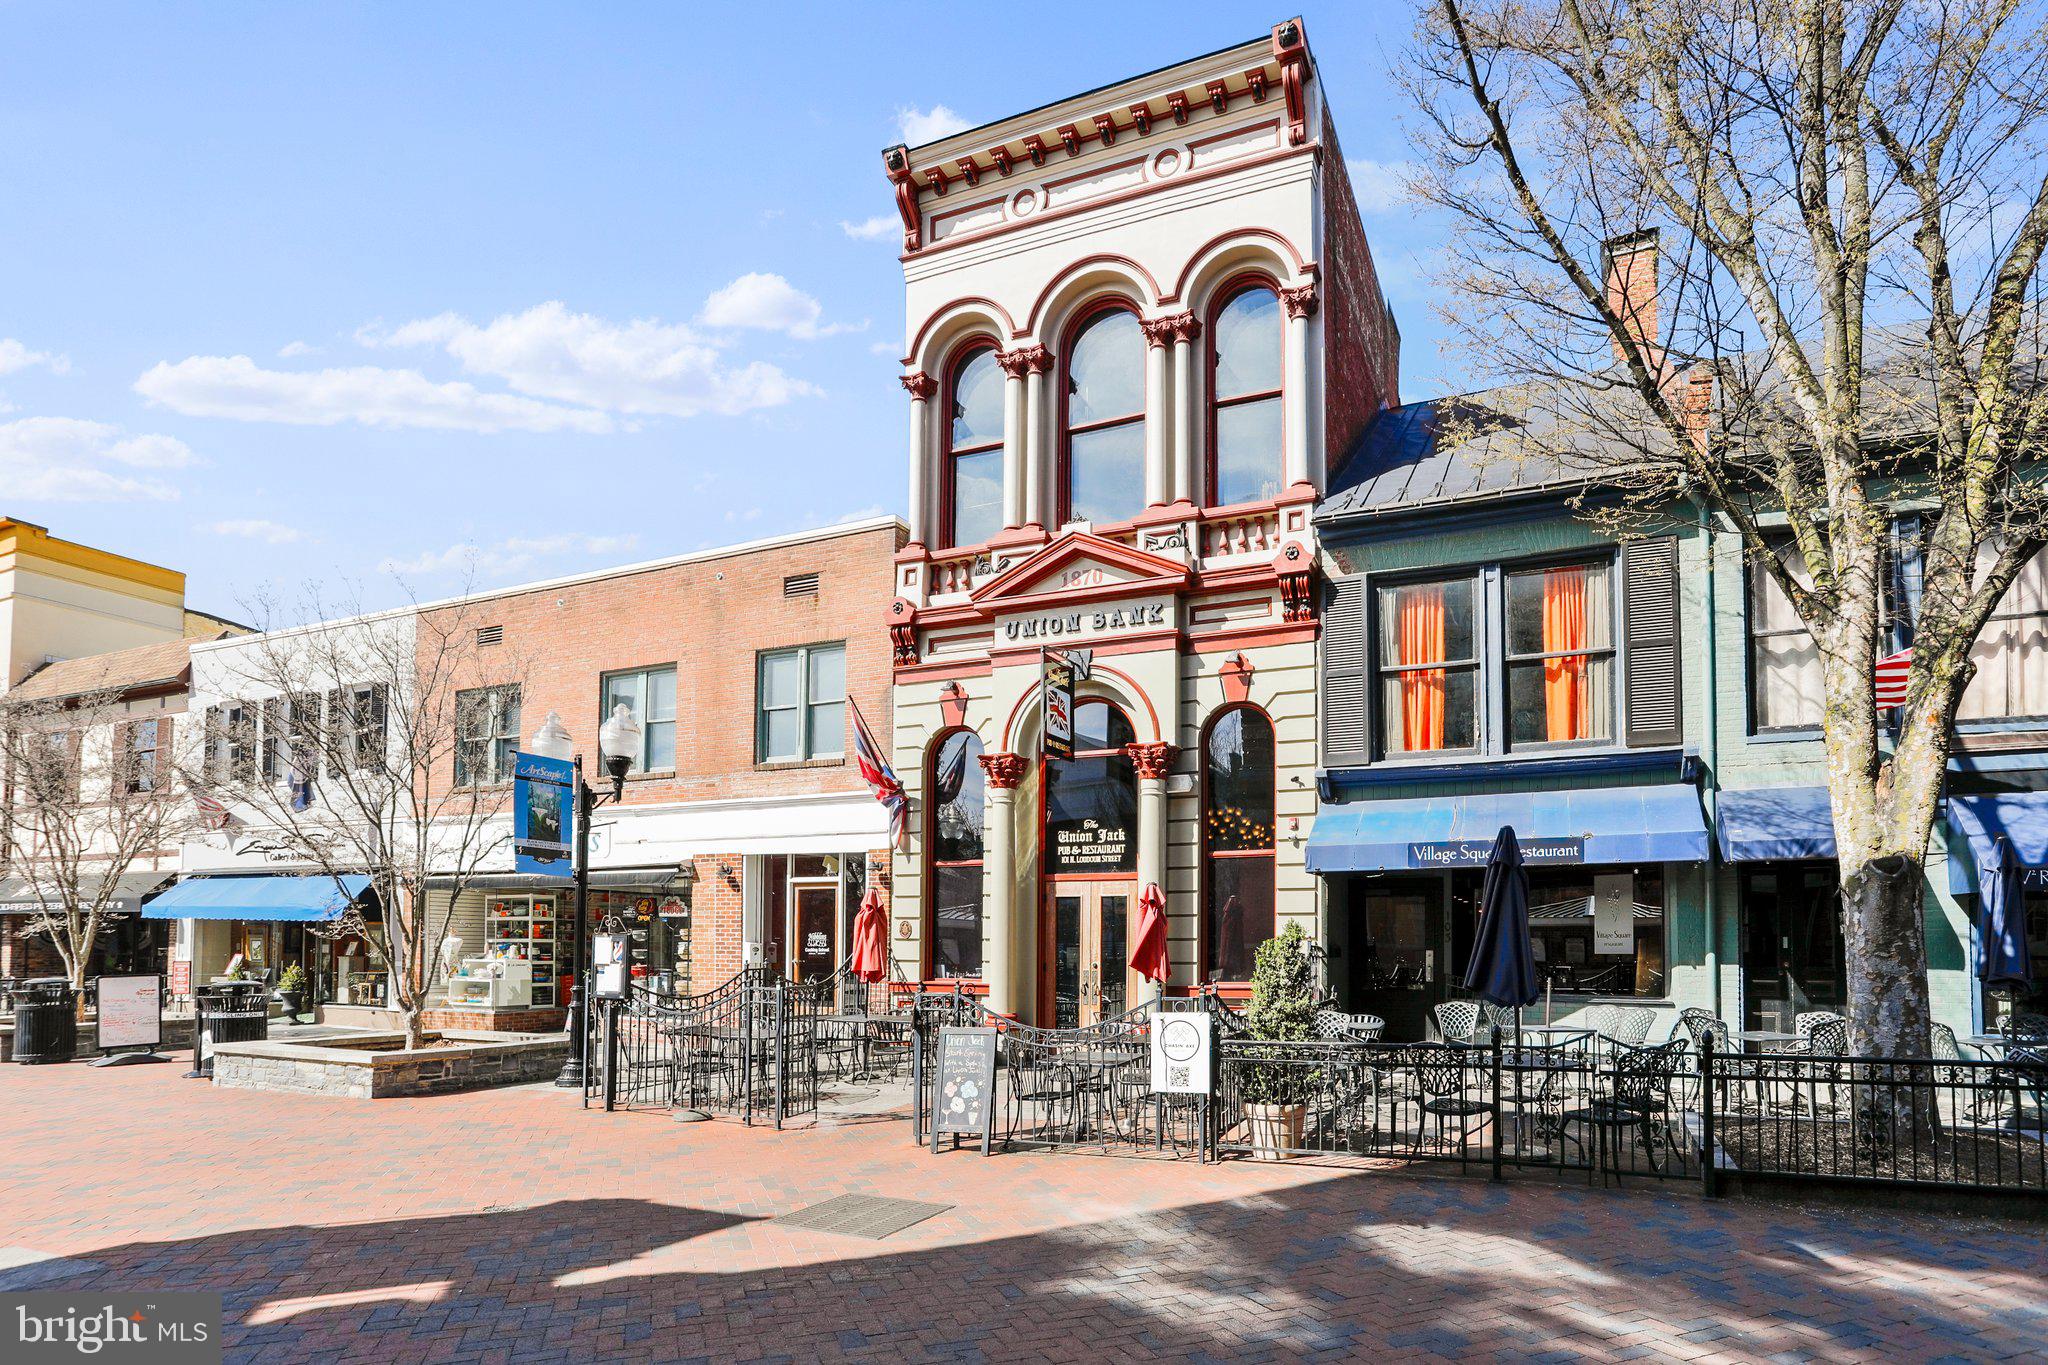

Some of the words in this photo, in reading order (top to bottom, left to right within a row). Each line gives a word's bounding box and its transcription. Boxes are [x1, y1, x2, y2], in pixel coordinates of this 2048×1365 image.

[1061, 568, 1103, 587] 1870
[1004, 613, 1081, 640] UNION
[1092, 603, 1164, 631] BANK
[1083, 819, 1099, 830] The
[1058, 830, 1093, 843] Union
[1097, 828, 1126, 843] Jack
[269, 851, 289, 862] Gallery
[1057, 845, 1071, 856] PUB
[1071, 845, 1081, 855] &
[1082, 844, 1126, 855] RESTAURANT
[1413, 845, 1457, 863] Village
[1460, 844, 1491, 862] Squa
[1521, 844, 1579, 858] estaurant
[1596, 930, 1613, 940] Village
